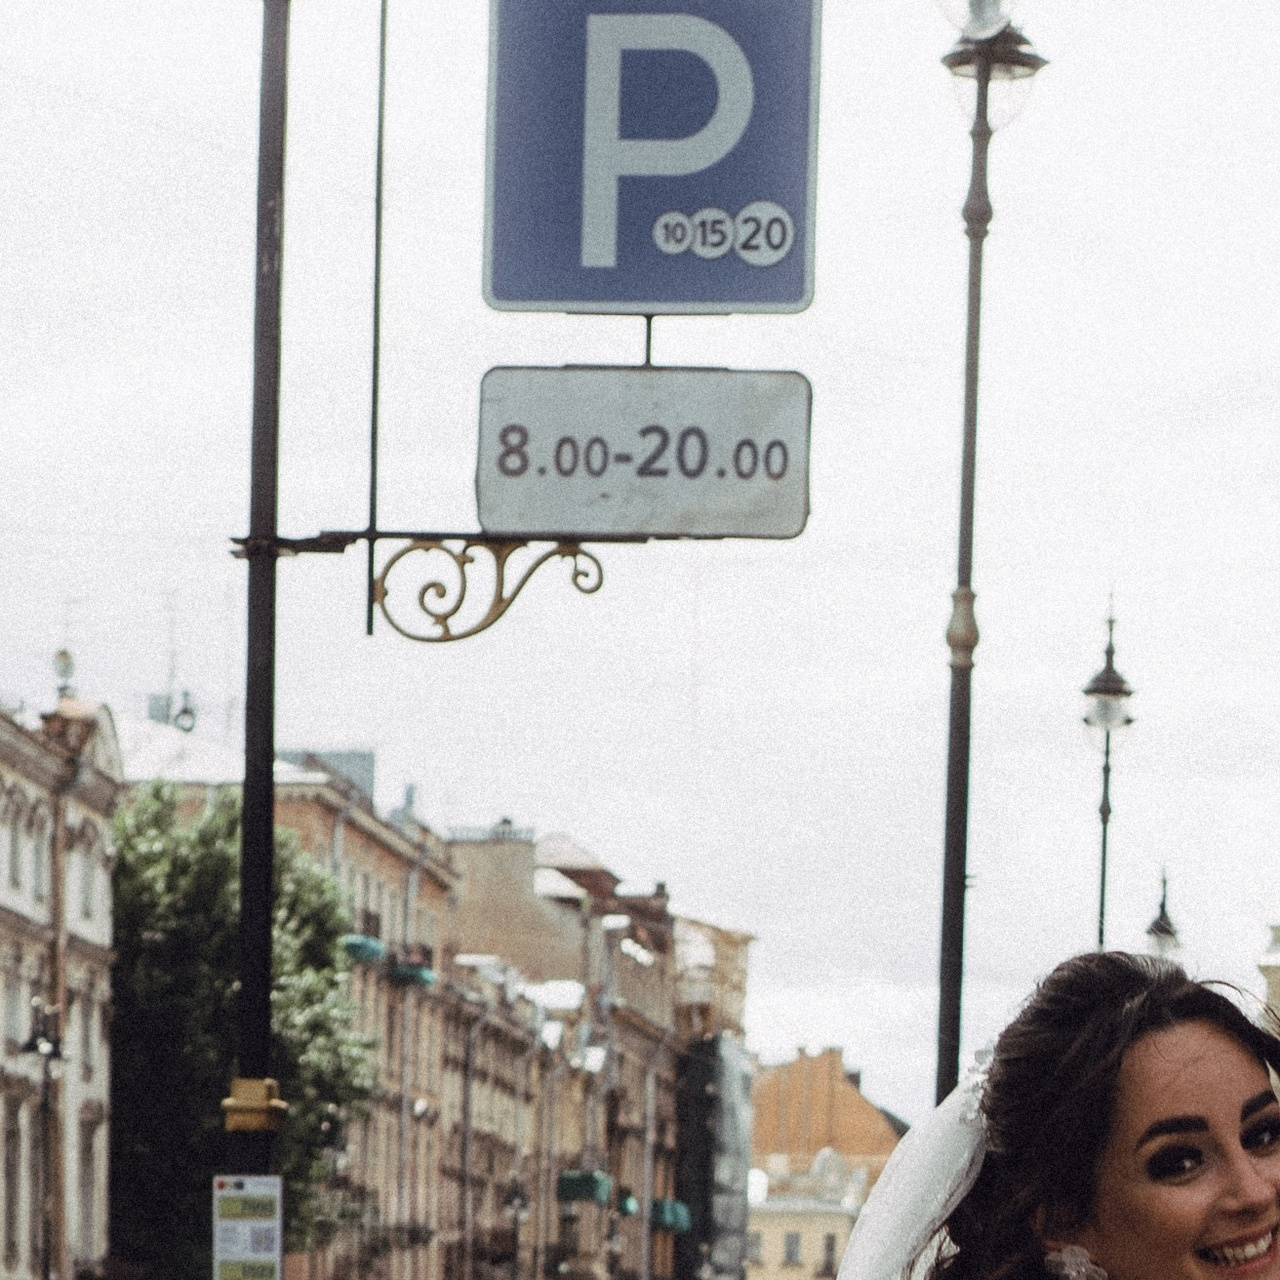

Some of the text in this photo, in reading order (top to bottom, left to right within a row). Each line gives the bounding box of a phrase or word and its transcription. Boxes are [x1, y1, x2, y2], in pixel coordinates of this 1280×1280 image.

[581, 13, 754, 269] P
[662, 216, 788, 251] 10 15 20
[497, 423, 789, 481] 8.00-20.00
